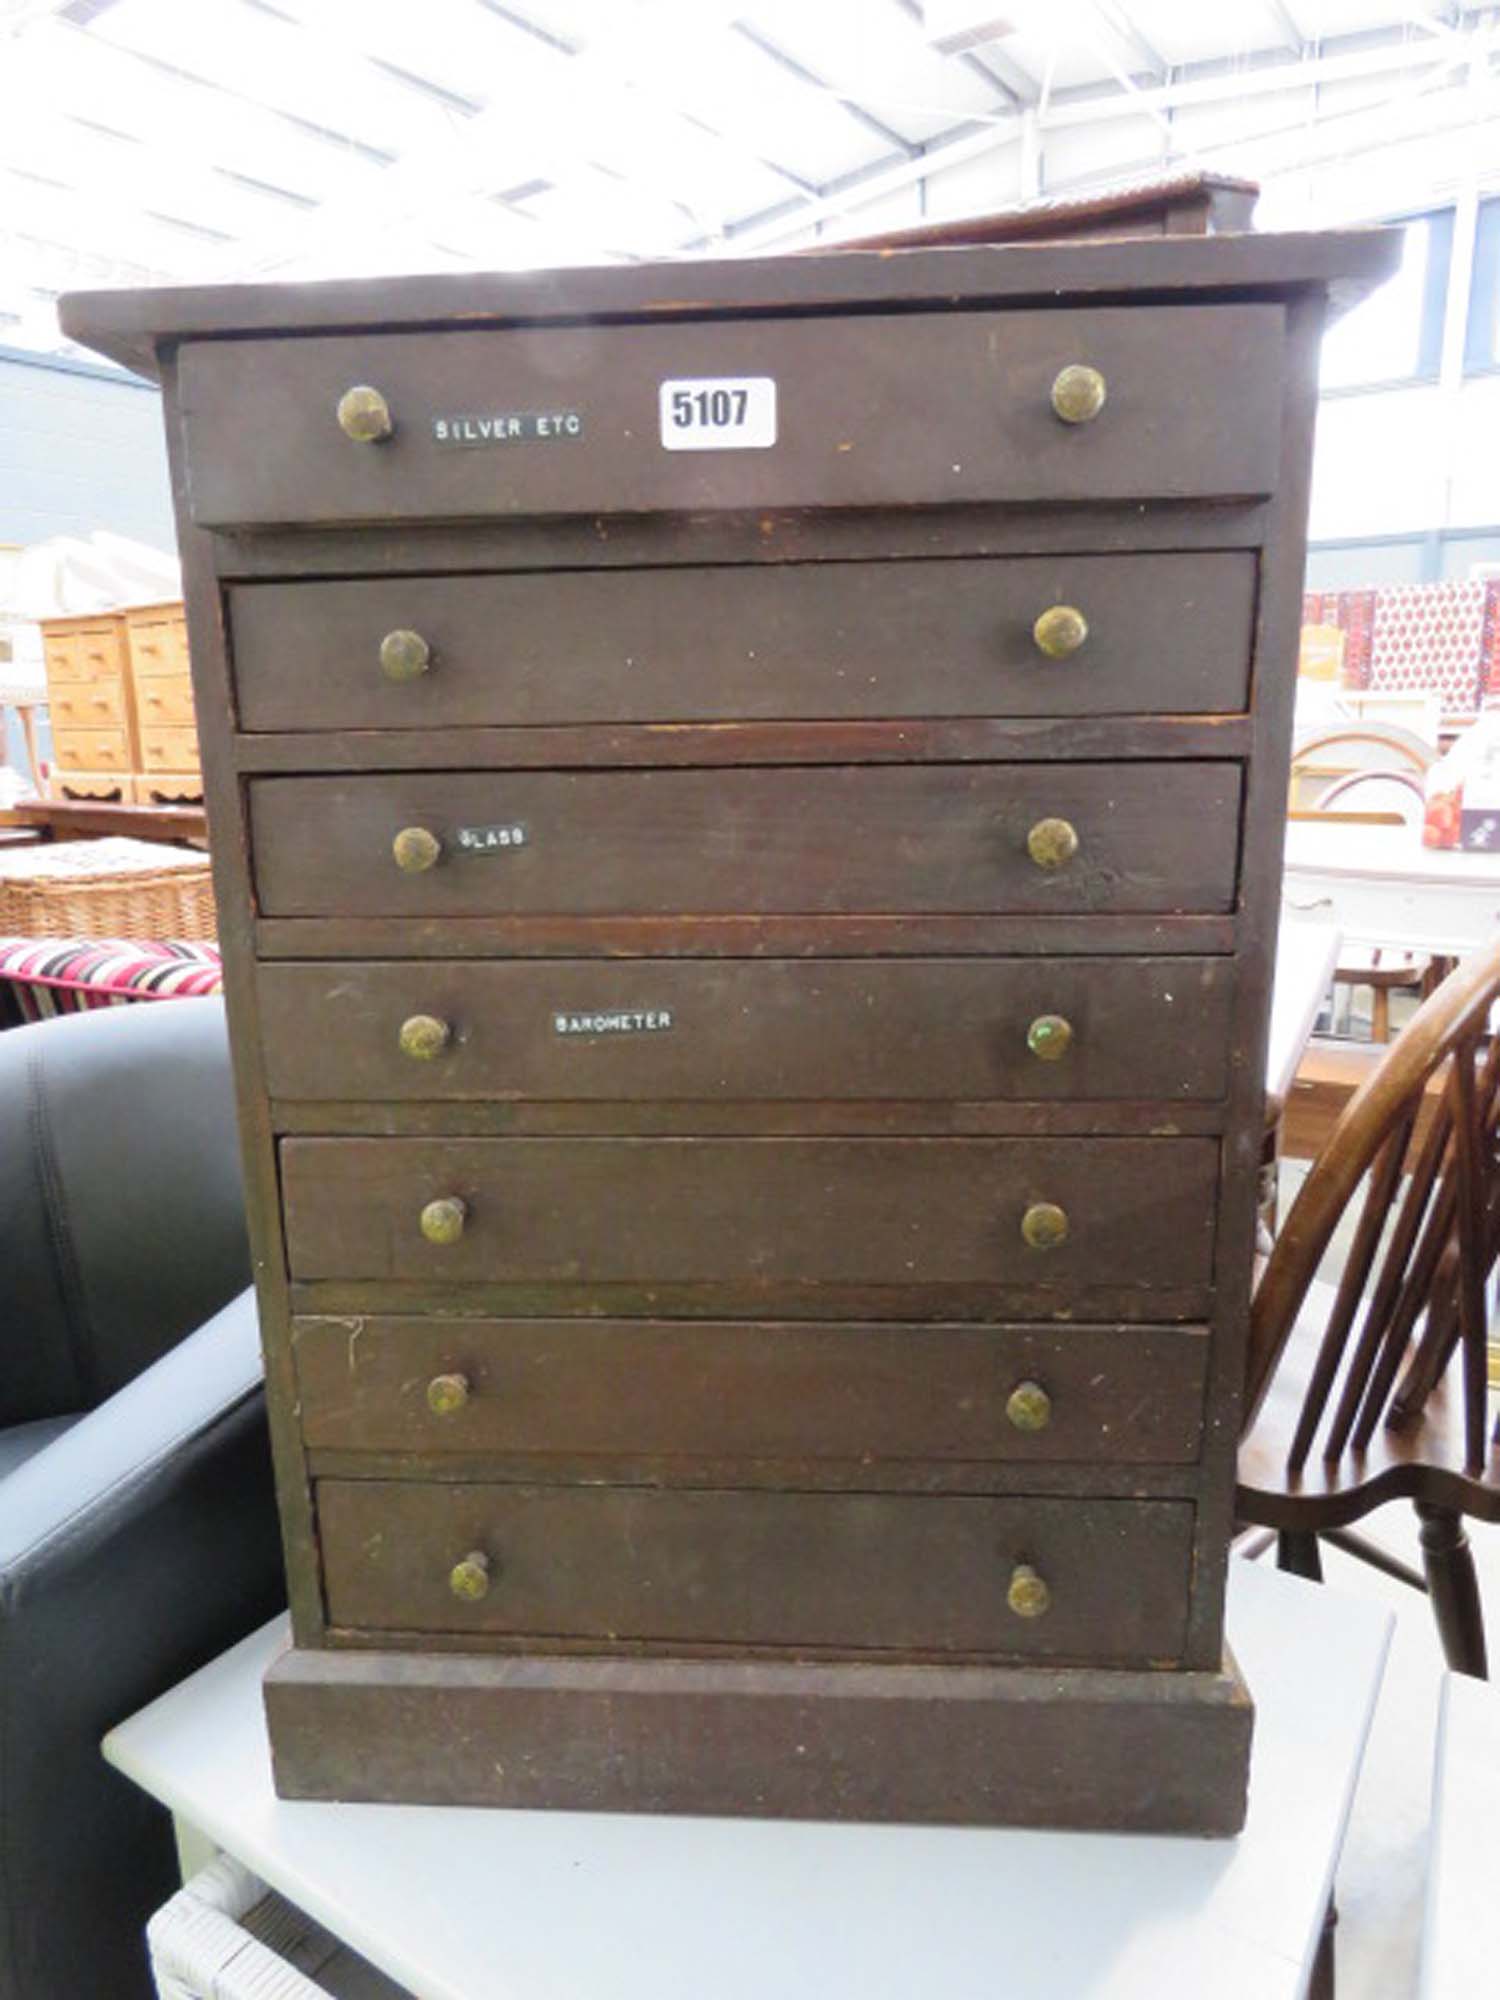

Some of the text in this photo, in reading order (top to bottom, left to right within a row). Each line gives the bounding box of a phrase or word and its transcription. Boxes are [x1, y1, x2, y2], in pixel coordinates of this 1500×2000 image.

[672, 389, 748, 428] 5107
[435, 416, 580, 440] SILVER ETC
[555, 1011, 671, 1033] BAROMETER
